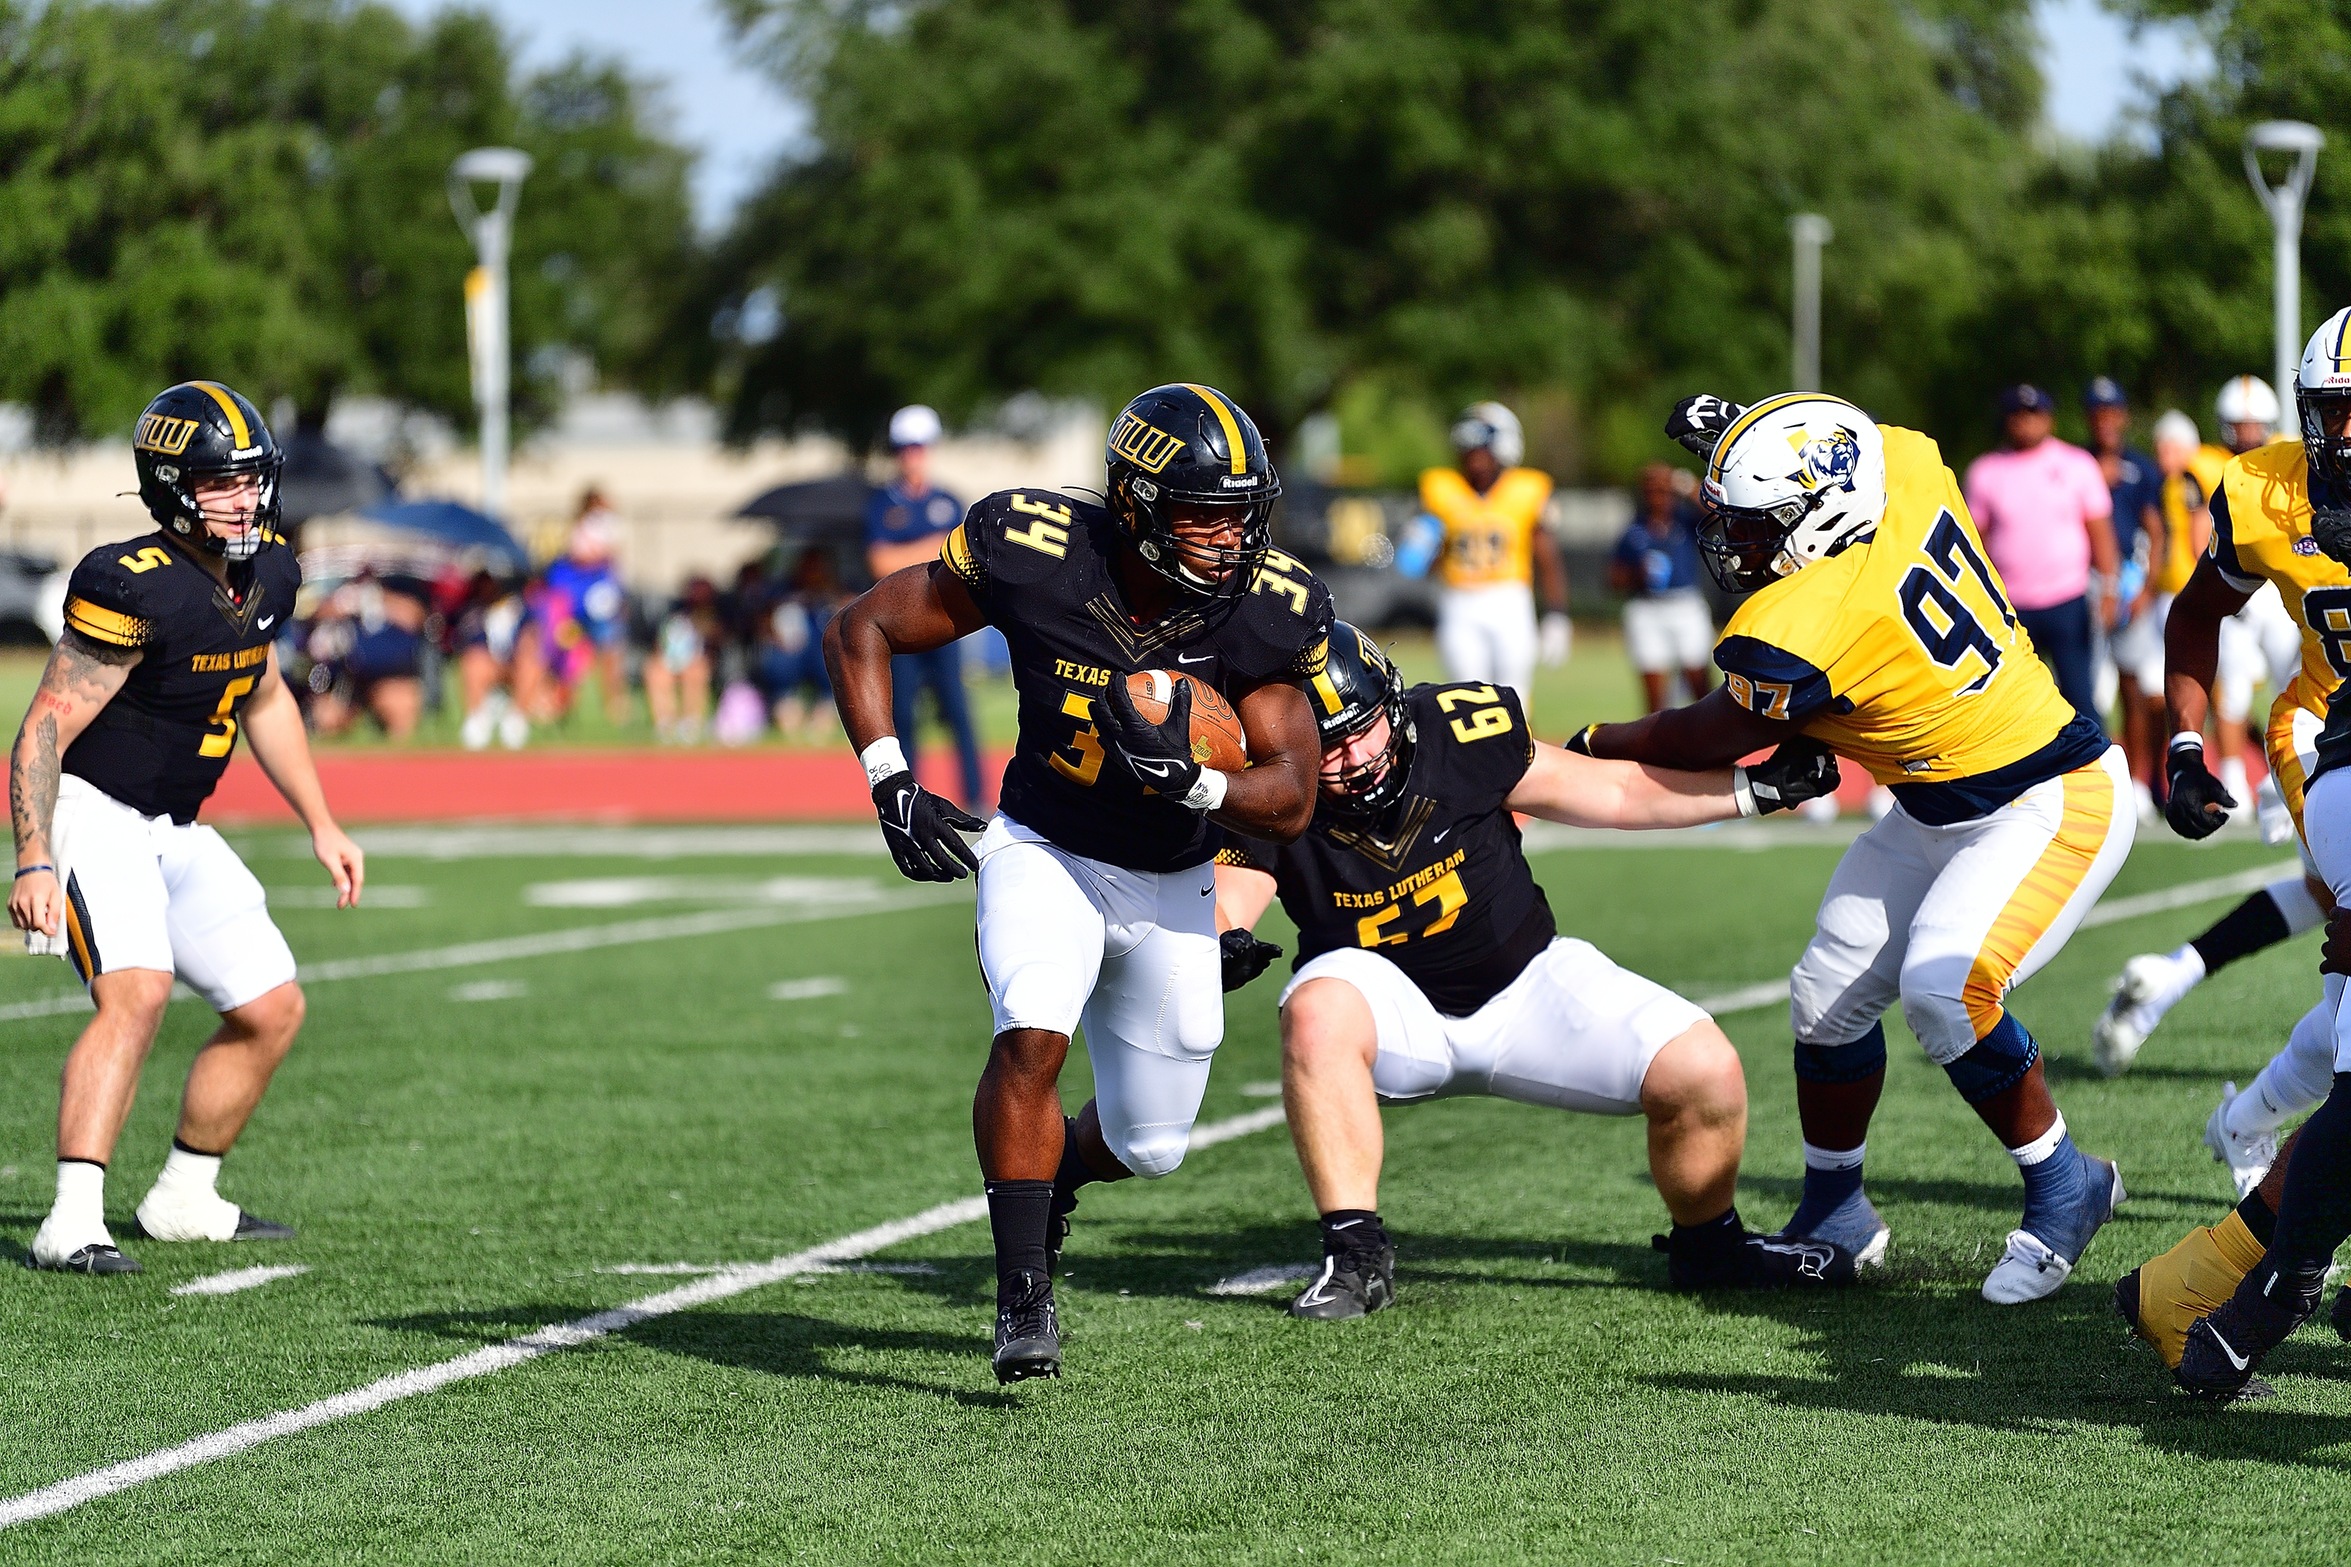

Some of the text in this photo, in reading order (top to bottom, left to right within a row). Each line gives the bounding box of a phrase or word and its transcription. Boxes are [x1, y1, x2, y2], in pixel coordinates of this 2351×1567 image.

[1108, 410, 1187, 474] TLU
[1223, 475, 1258, 489] Riddell
[1003, 492, 1072, 561] 34
[1895, 505, 2018, 698] 97
[191, 652, 231, 673] TEXAS
[1054, 658, 1112, 687] TEXAS
[198, 674, 255, 758] 5
[1725, 671, 1793, 720] 97
[1333, 848, 1466, 908] TEXAS LUTHERAN
